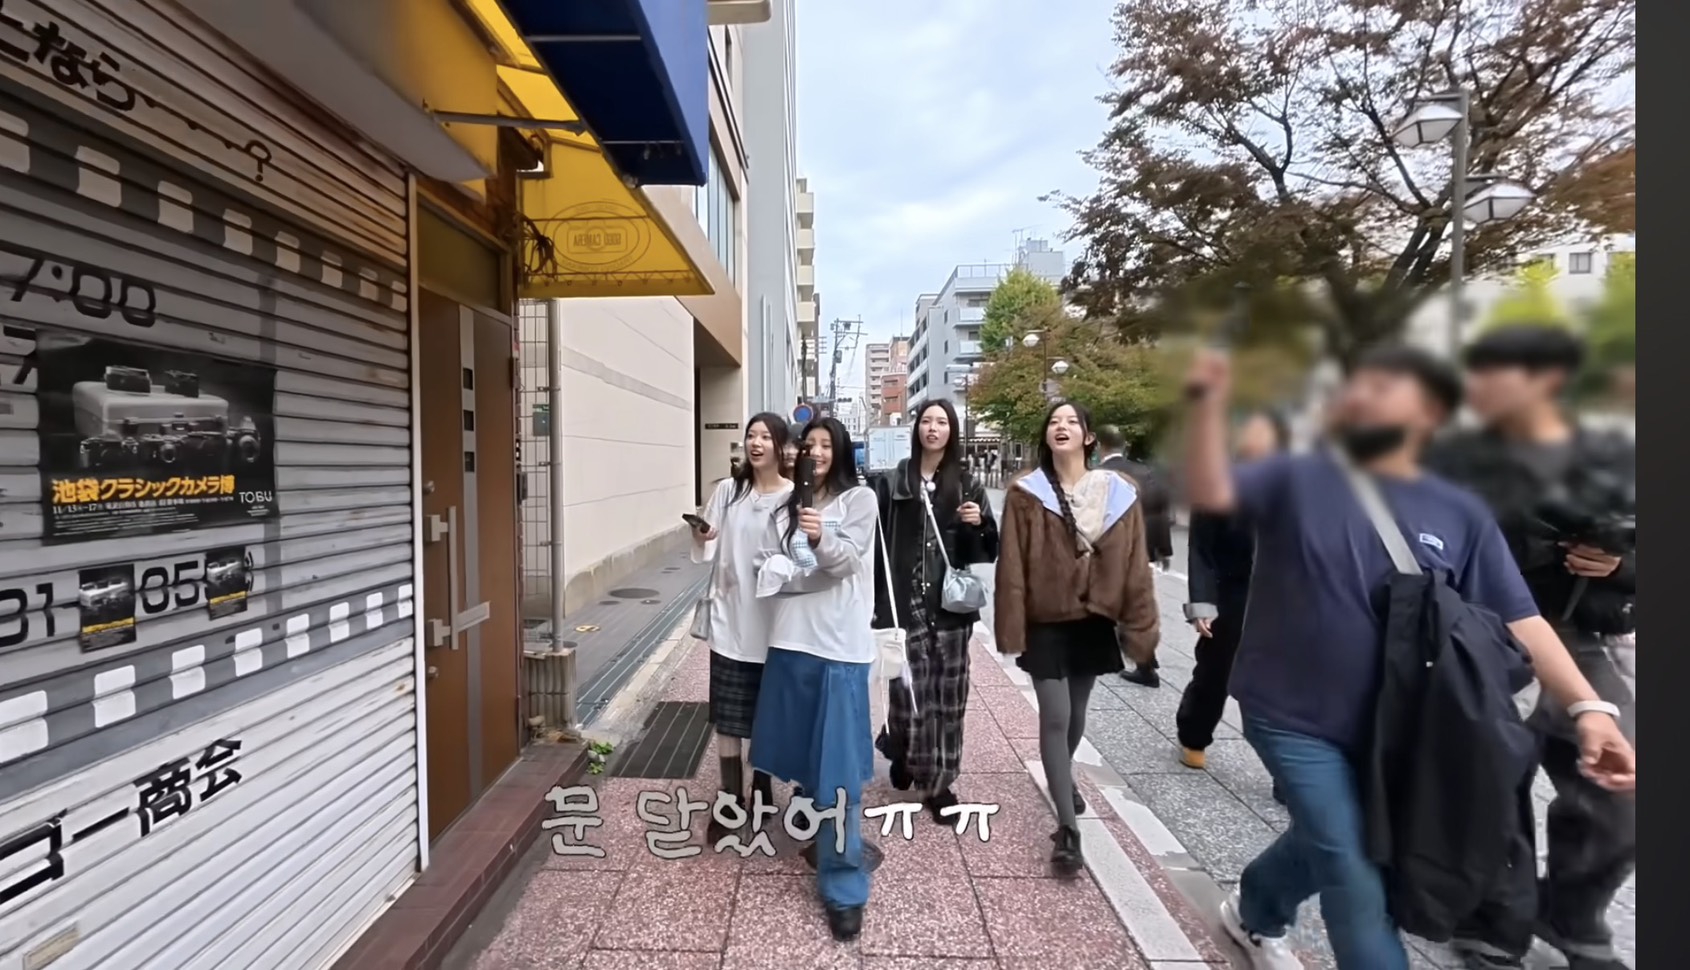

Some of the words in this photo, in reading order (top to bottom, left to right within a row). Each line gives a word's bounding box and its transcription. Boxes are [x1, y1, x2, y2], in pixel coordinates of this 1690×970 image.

[52, 474, 236, 504] 池袋クラシックカメラ博
[238, 490, 273, 504] TOBU
